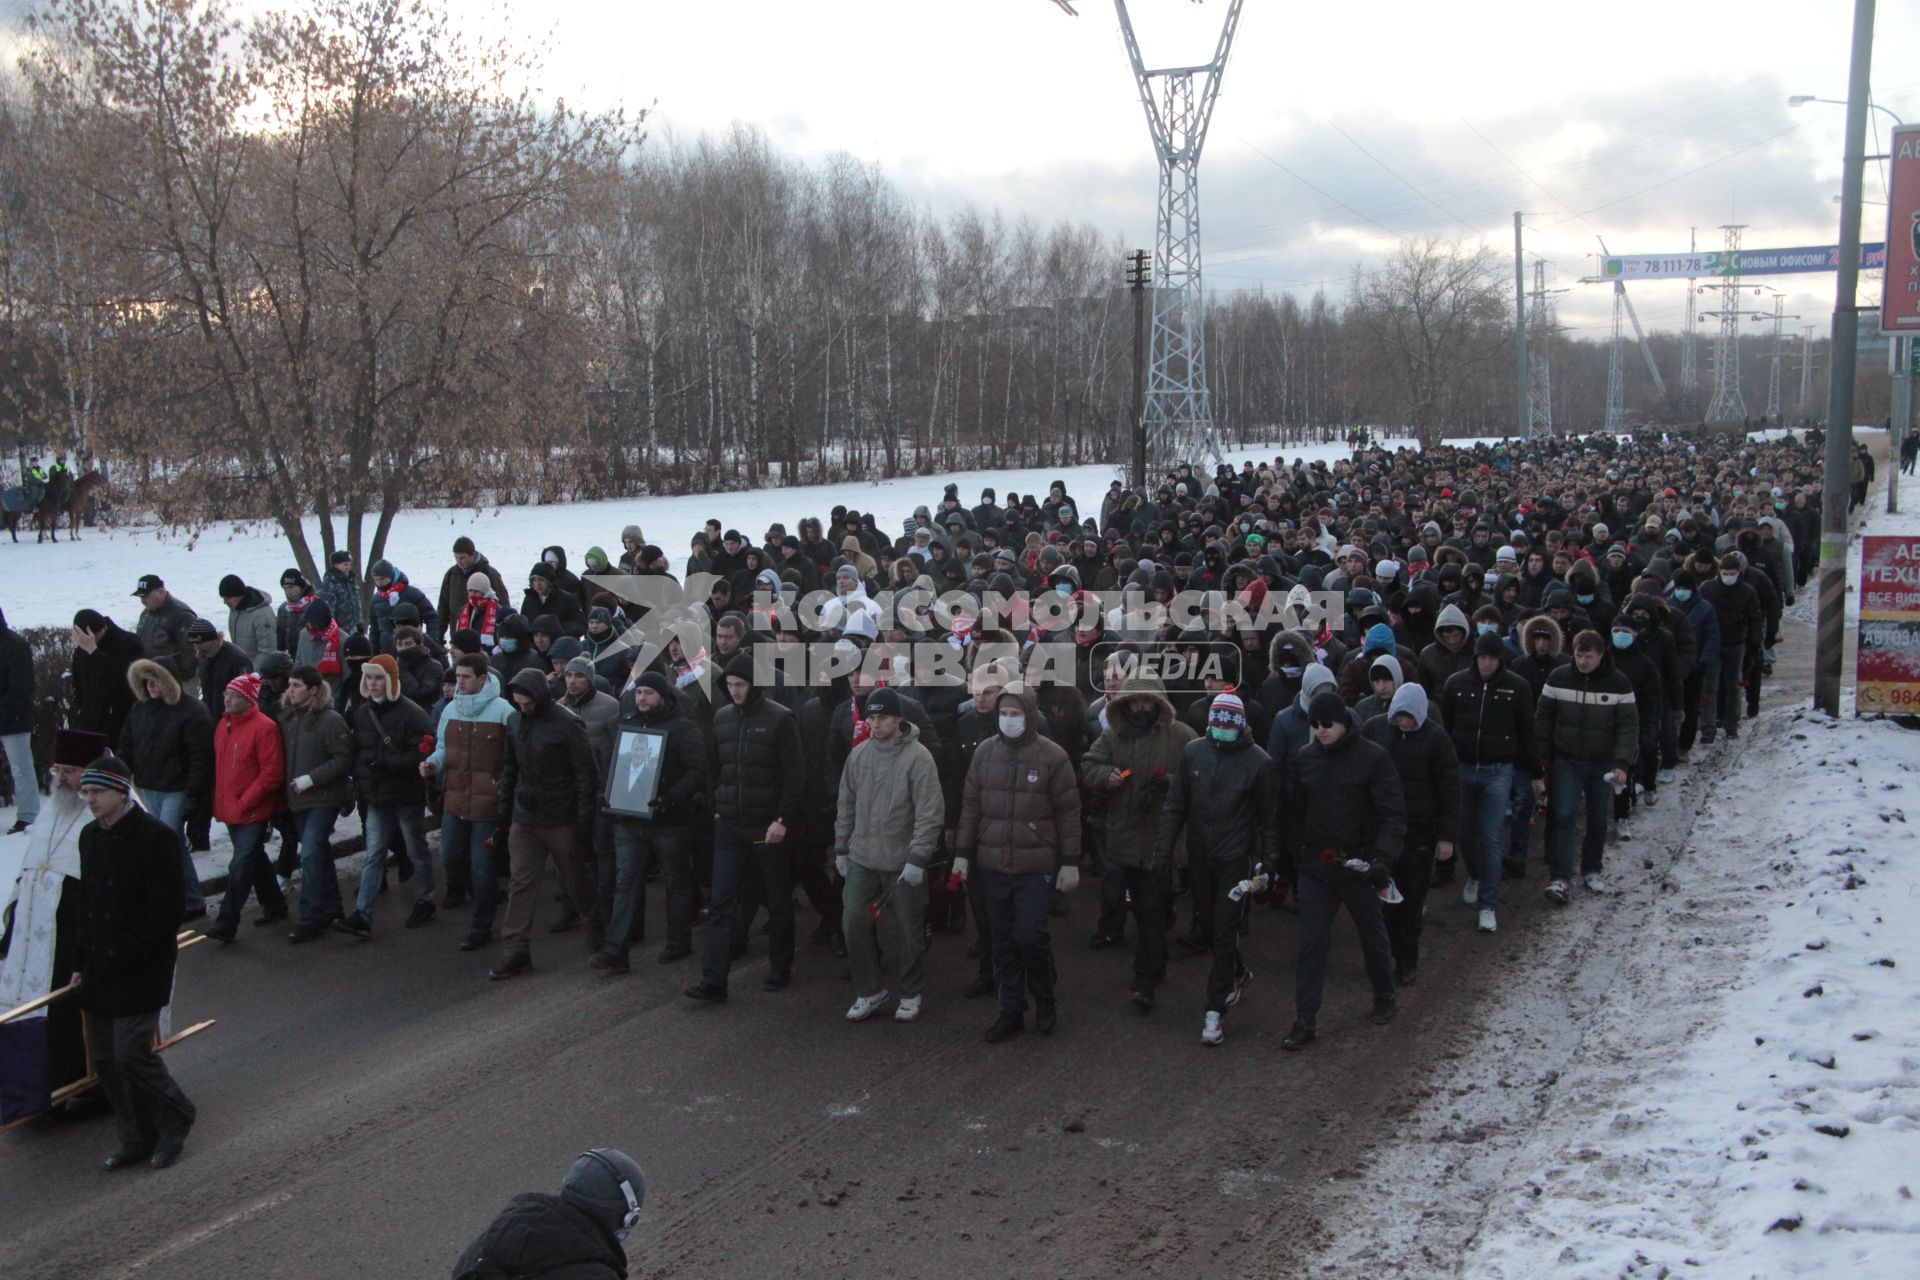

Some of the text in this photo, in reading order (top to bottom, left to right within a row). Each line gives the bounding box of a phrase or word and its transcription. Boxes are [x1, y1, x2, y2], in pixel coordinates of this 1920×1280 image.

[1731, 254, 1739, 269] С
[1740, 256, 1777, 269] НОВЫМ
[1868, 591, 1892, 603] ВСЕ
